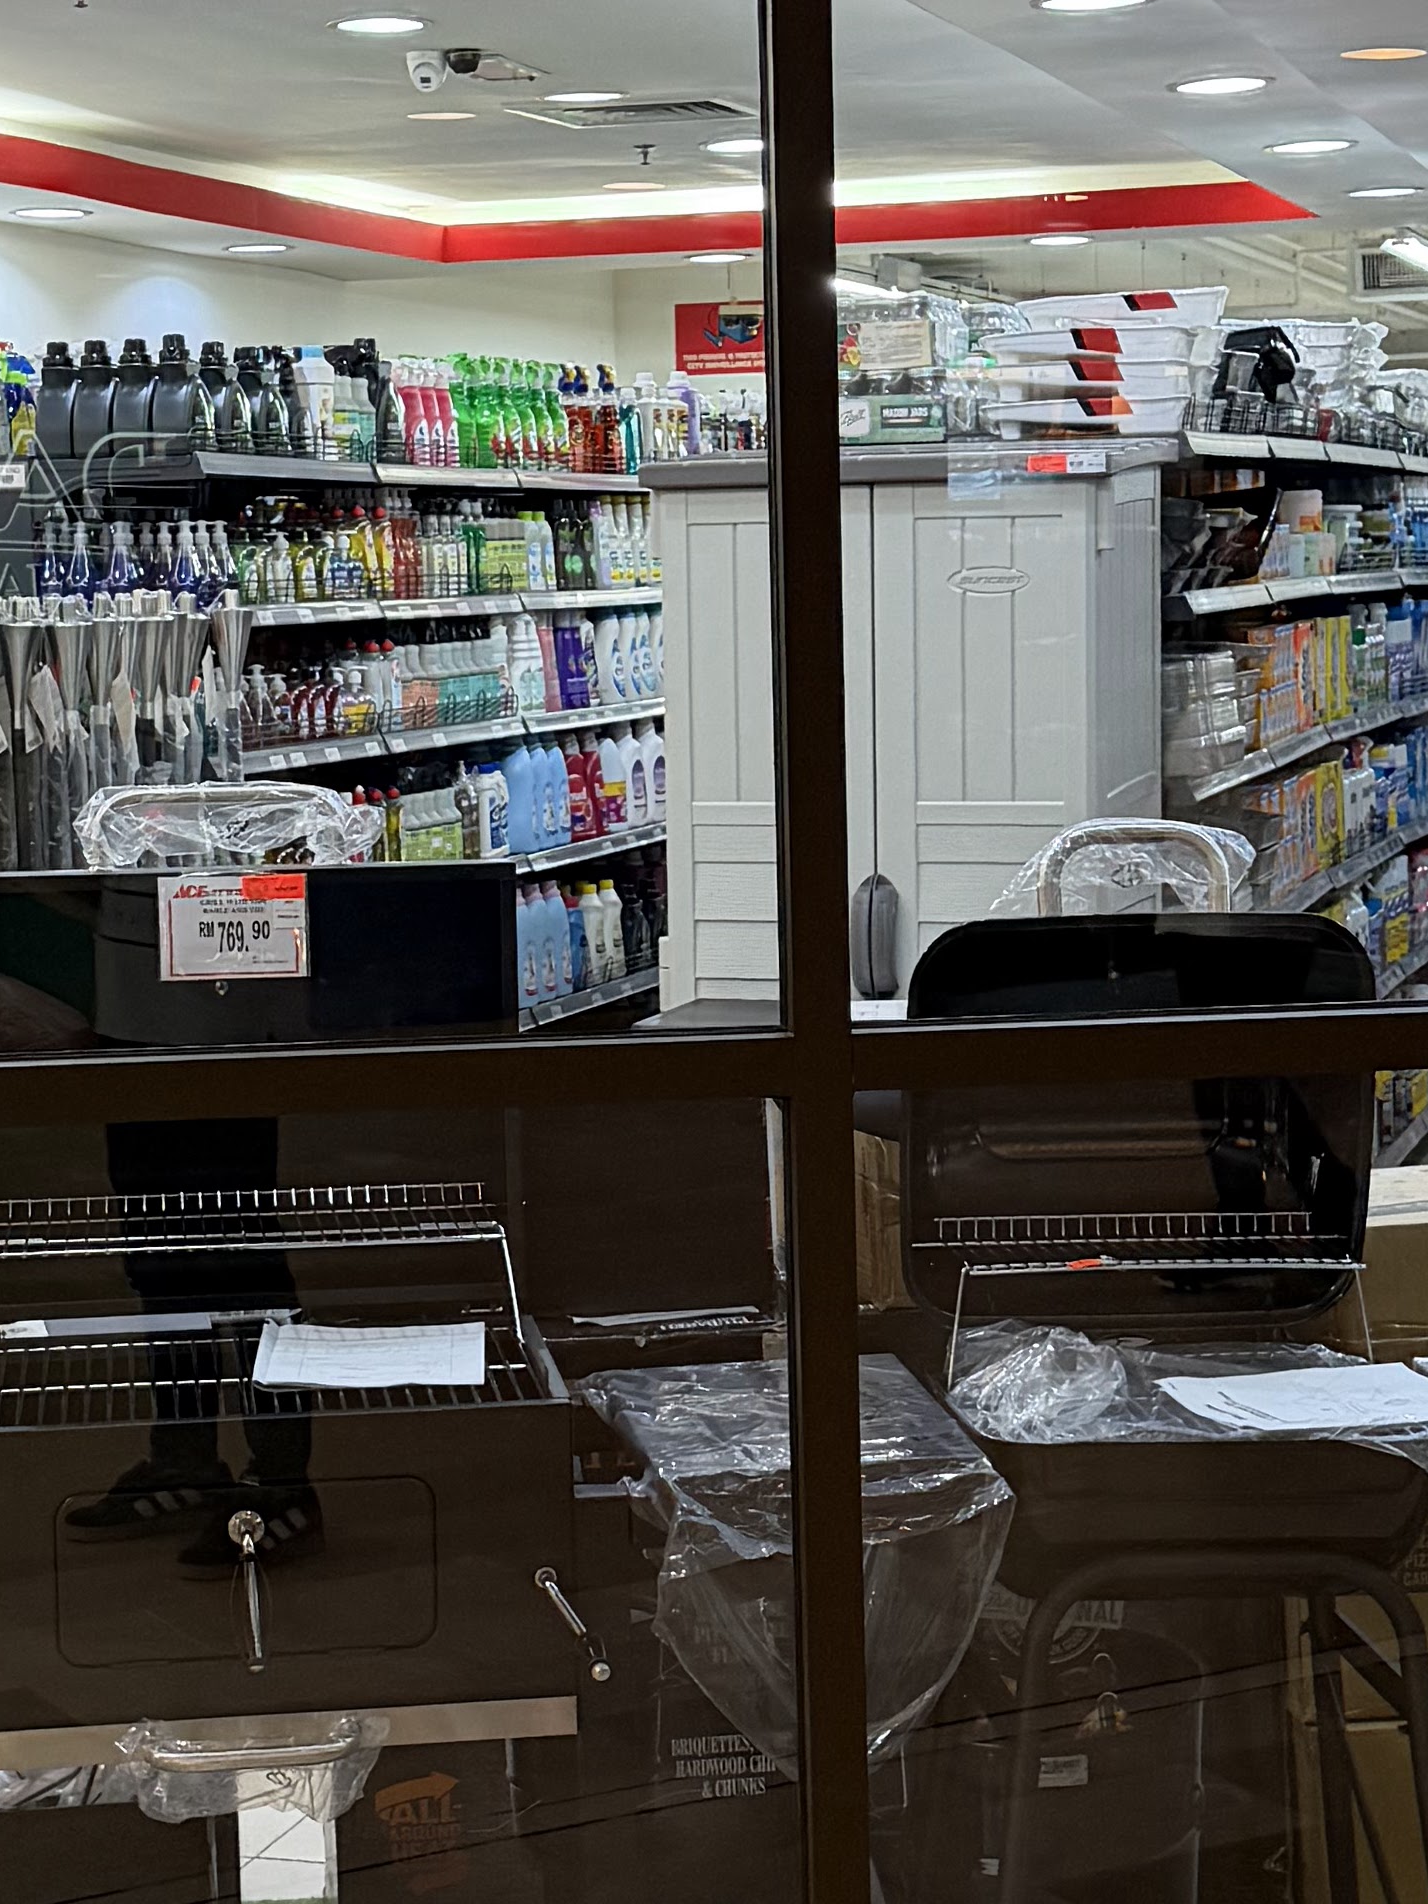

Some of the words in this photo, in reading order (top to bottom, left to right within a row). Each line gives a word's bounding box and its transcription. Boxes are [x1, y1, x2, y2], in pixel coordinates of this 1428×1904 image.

[173, 884, 208, 899] ACE
[199, 921, 214, 937] RM
[252, 920, 270, 940] 90
[676, 1756, 747, 1778] HARDWOOD
[715, 1777, 766, 1797] CHUNKS
